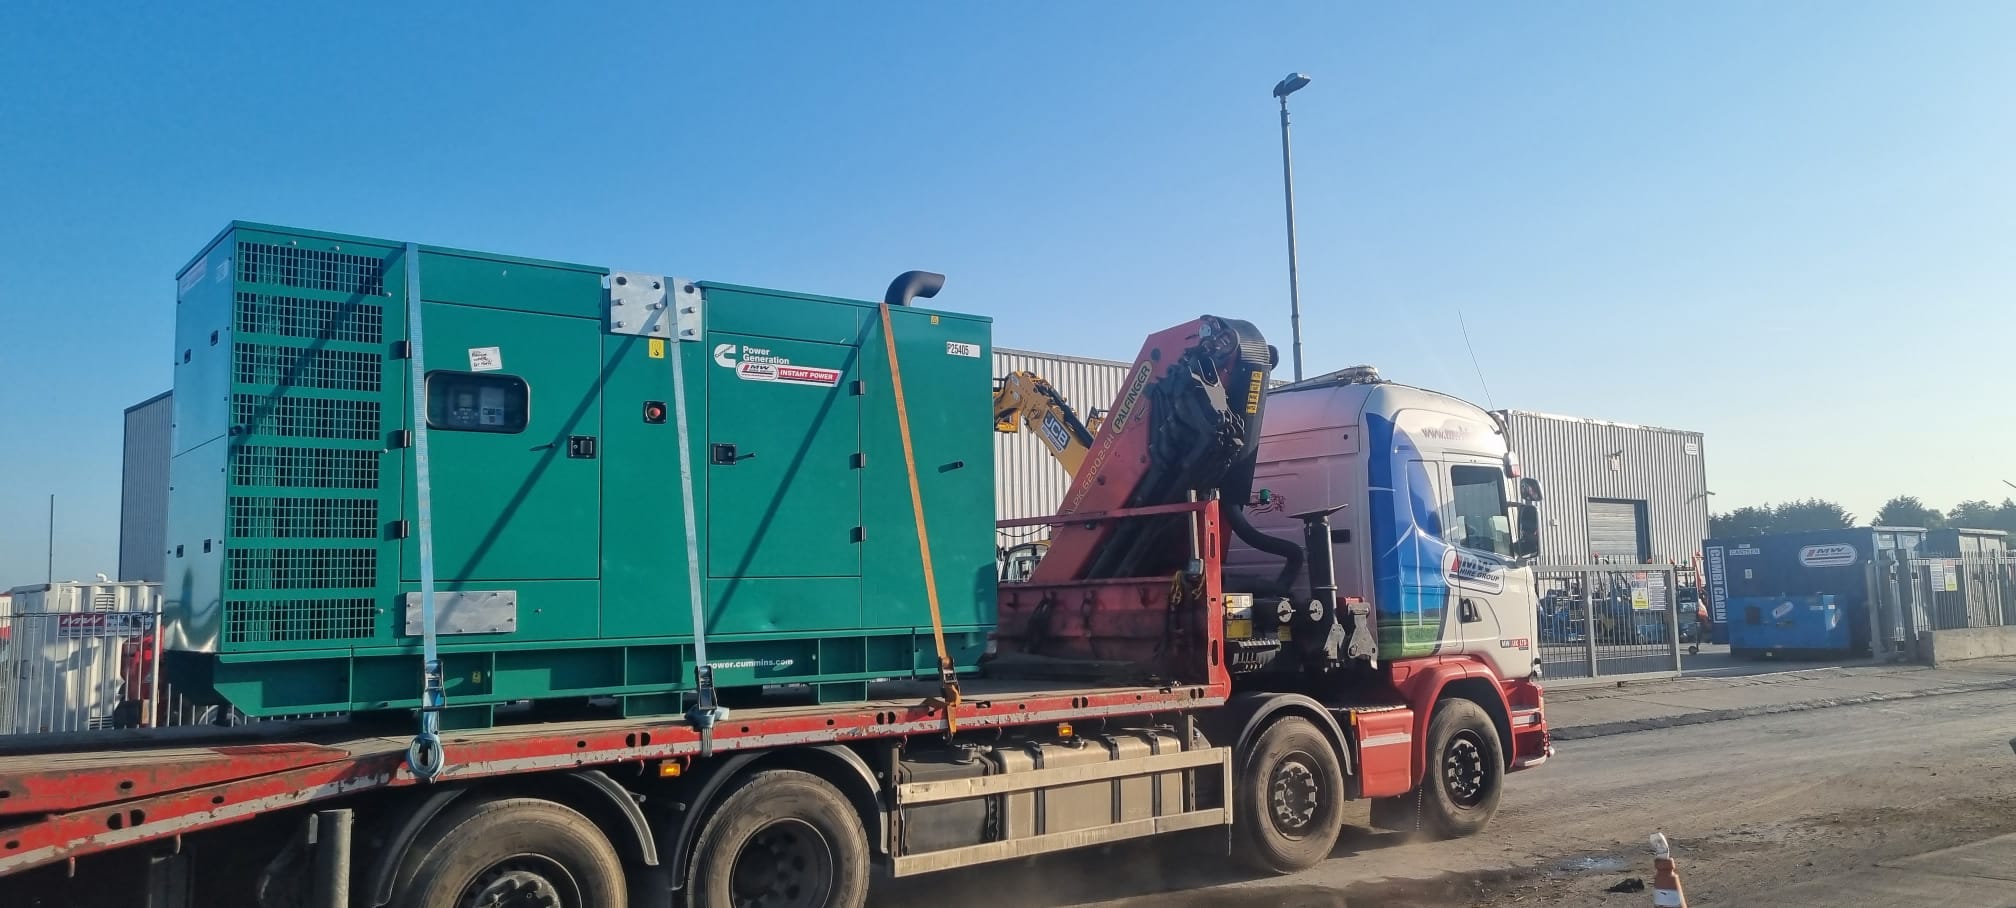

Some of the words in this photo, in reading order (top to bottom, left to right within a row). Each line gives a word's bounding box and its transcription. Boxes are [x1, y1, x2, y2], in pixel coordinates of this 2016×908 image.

[743, 346, 770, 355] Power
[947, 343, 969, 355] P25405
[743, 354, 790, 365] Generation
[780, 370, 808, 378] INSTANT
[809, 373, 833, 381] POWER
[1114, 364, 1151, 430] PALFINGER
[1044, 416, 1069, 447] JCB
[1709, 549, 1724, 585] COMBI
[1476, 572, 1500, 582] GROUP
[1713, 587, 1728, 620] CABIN
